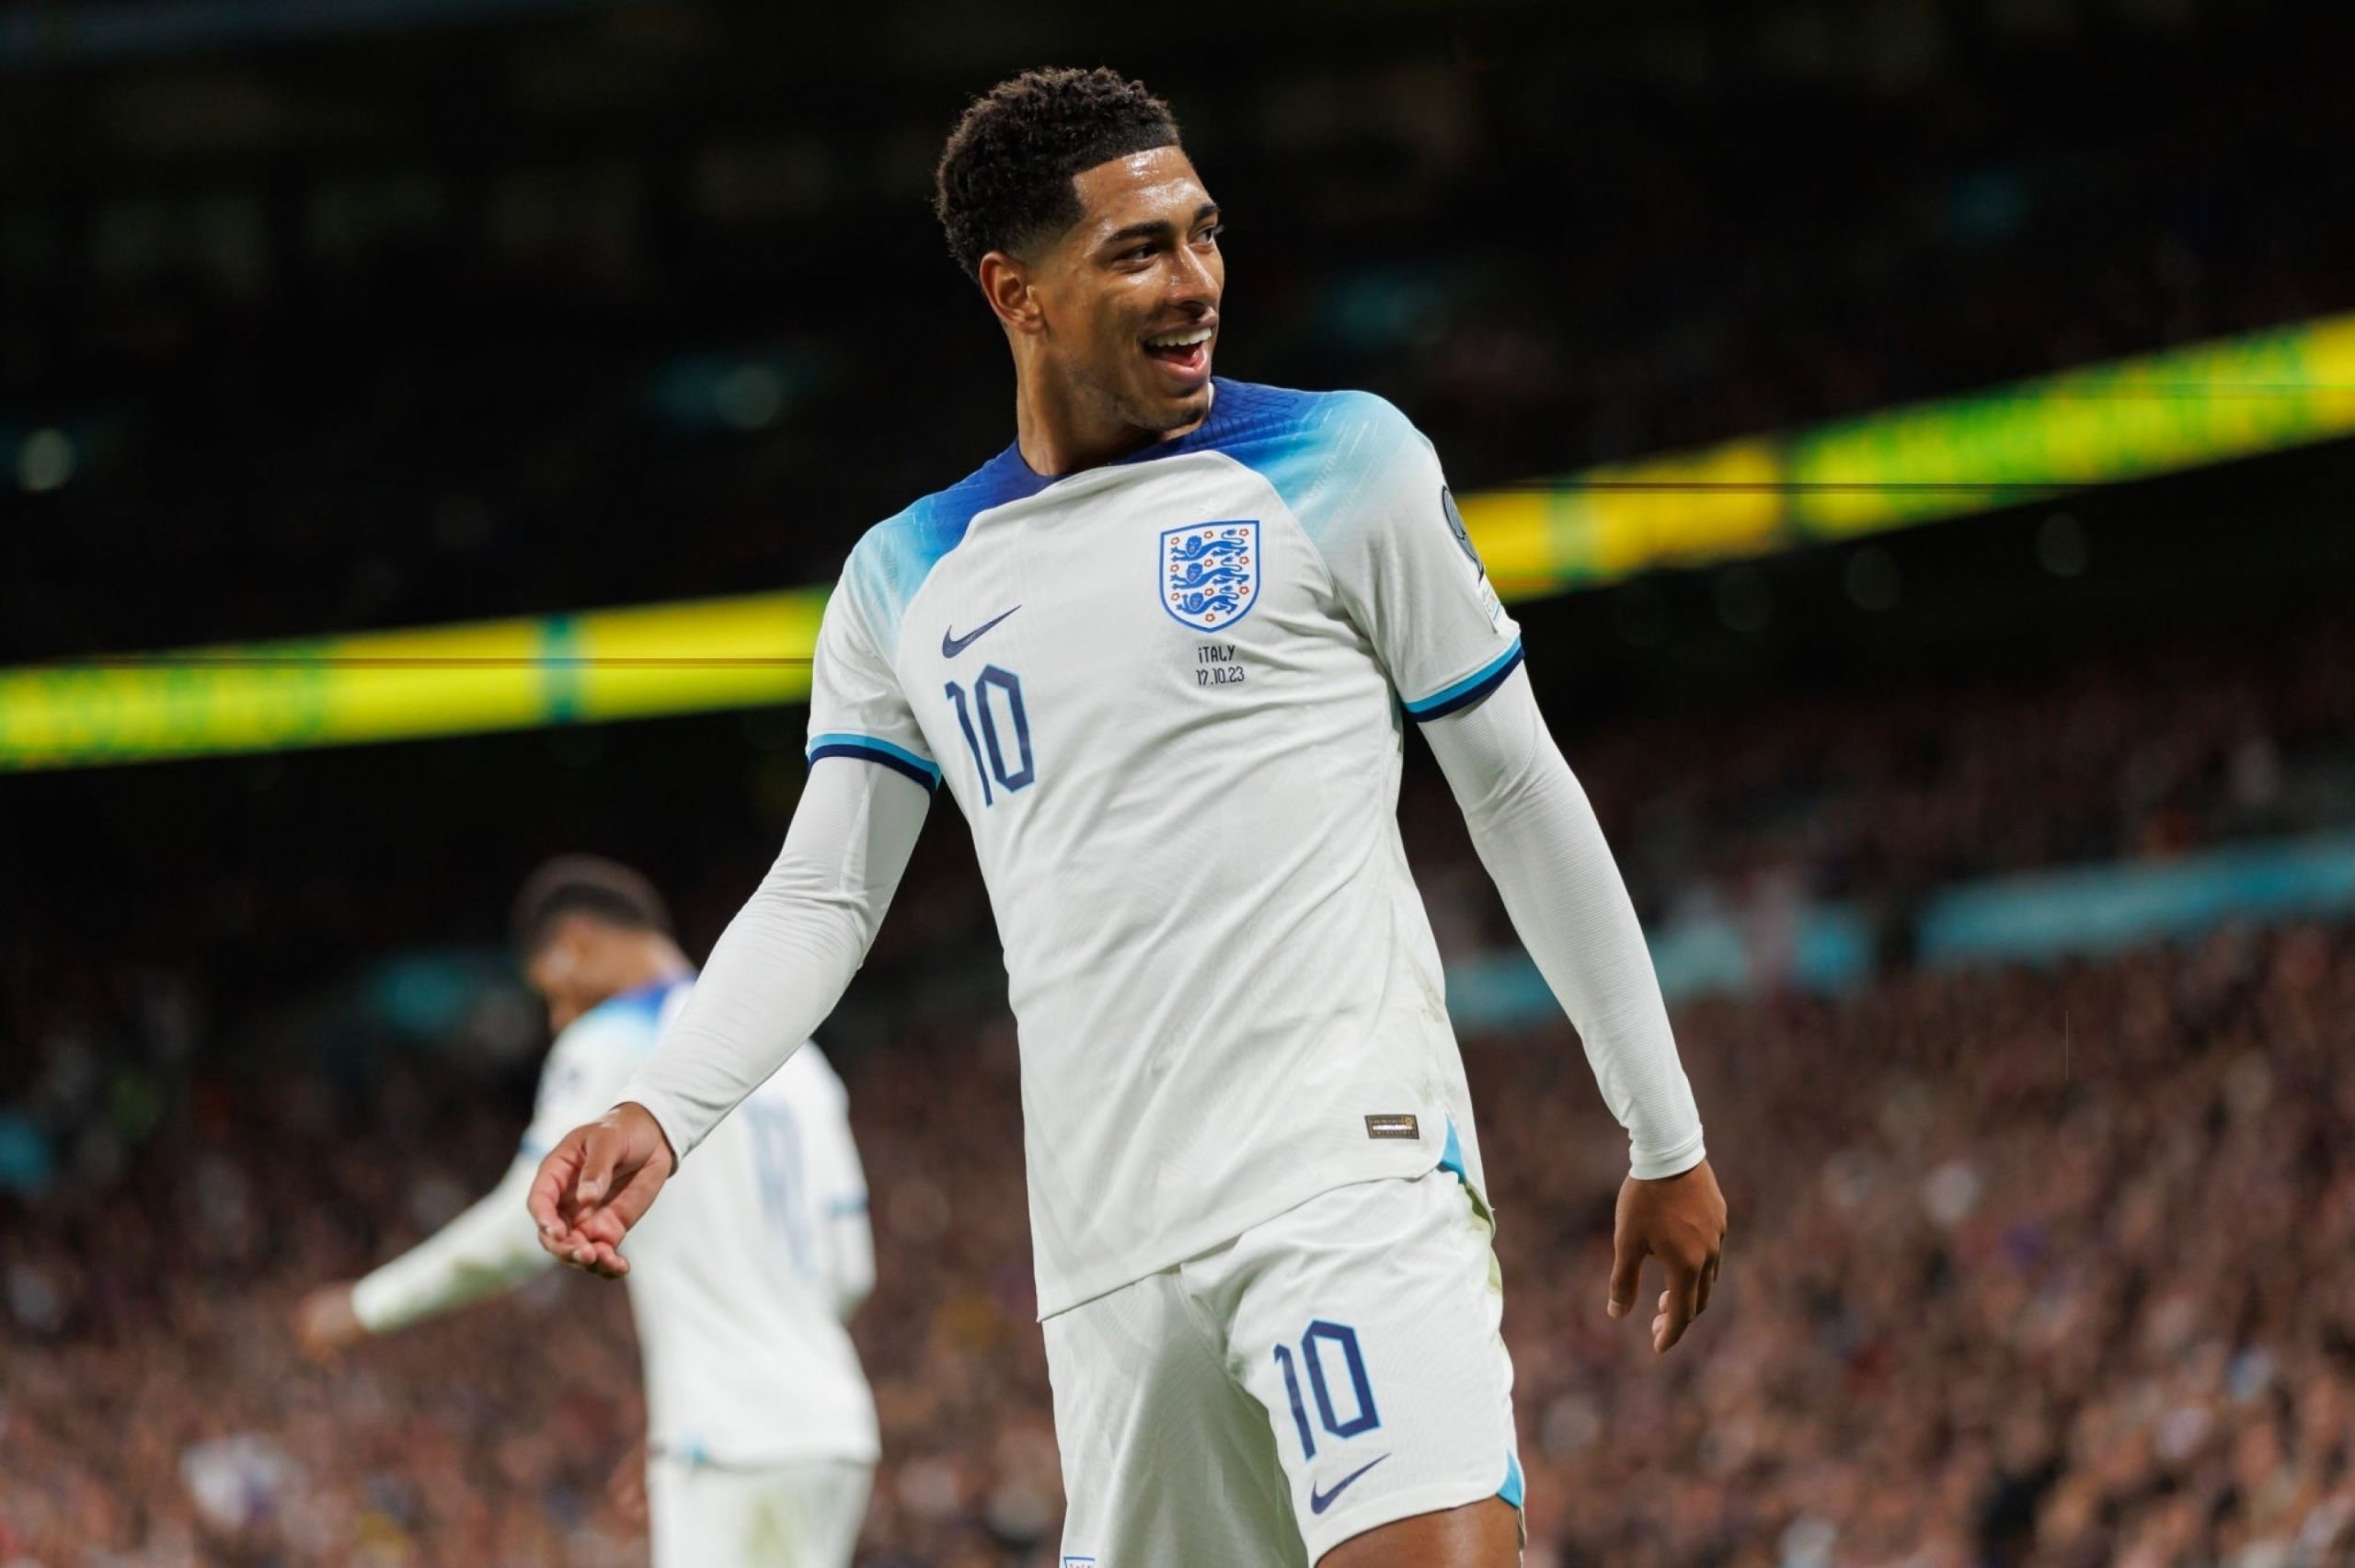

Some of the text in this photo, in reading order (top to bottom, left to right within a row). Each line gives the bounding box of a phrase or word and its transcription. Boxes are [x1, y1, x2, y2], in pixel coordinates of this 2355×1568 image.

[945, 664, 1034, 807] 10
[1196, 666, 1245, 686] 17.10.23
[1273, 1320, 1380, 1461] 10
